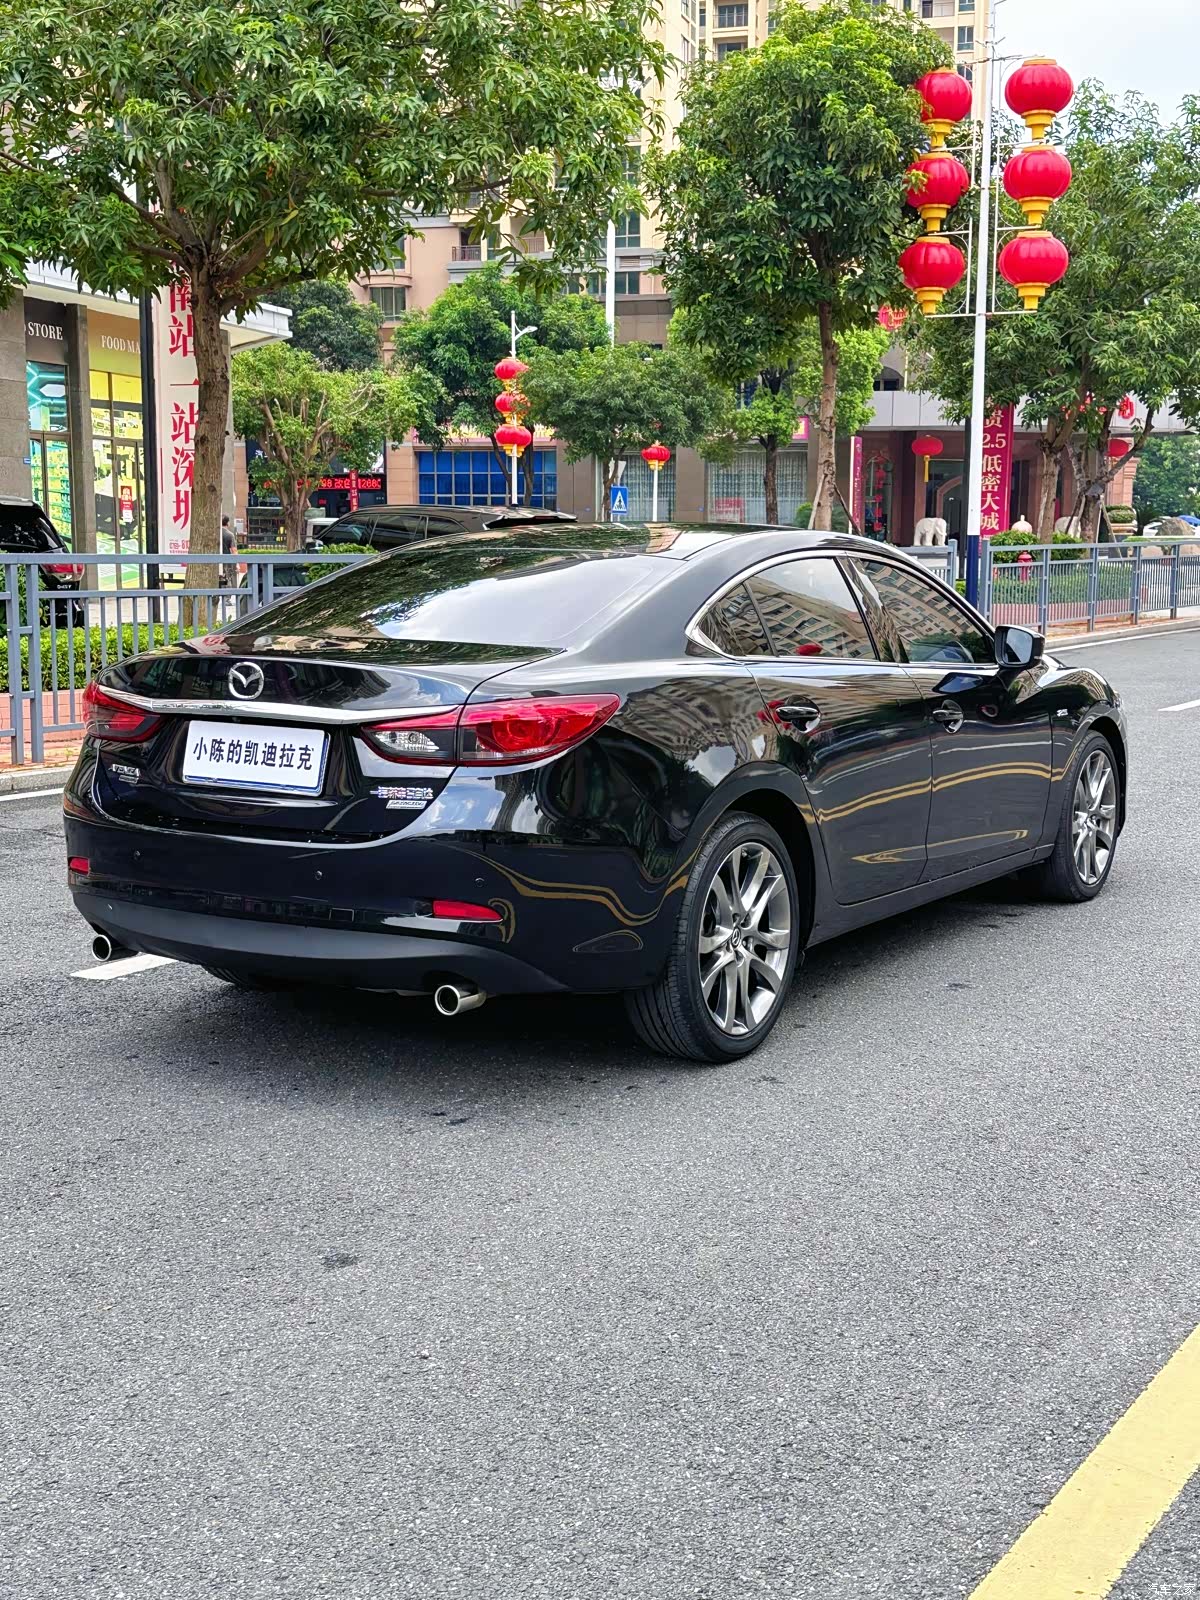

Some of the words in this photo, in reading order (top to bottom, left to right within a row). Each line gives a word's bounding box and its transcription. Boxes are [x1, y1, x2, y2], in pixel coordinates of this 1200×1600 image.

[27, 321, 63, 340] STORE
[101, 335, 126, 351] FOOD
[193, 736, 315, 770] 小陈的凯迪拉克
